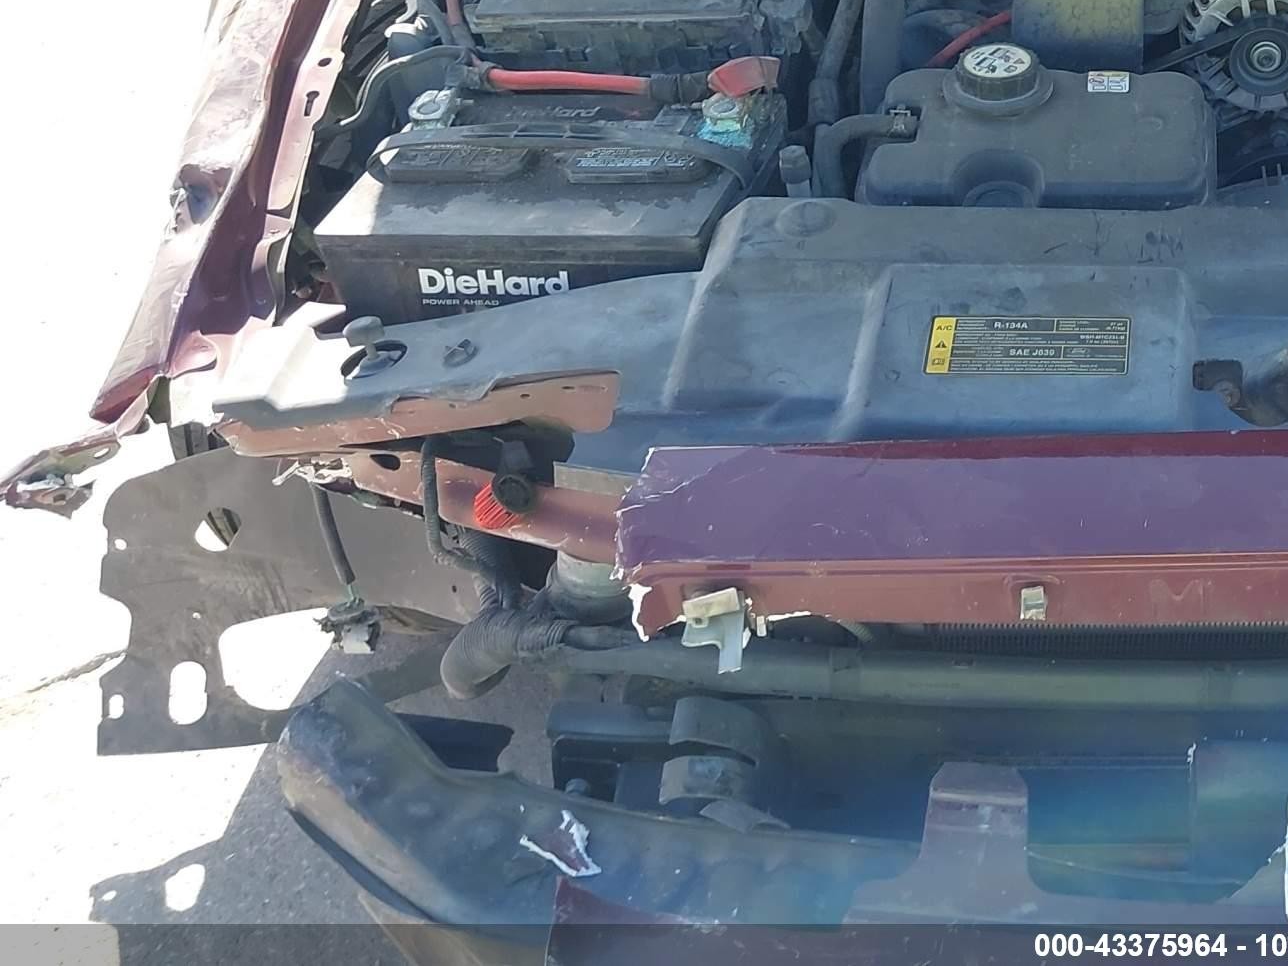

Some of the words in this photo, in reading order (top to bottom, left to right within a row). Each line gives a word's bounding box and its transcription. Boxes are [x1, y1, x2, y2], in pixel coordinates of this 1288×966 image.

[418, 267, 570, 296] DieHard
[422, 298, 460, 306] POWER
[463, 298, 500, 306] AHEAD
[935, 324, 953, 332] A/C
[993, 321, 1029, 330] R-134A
[1009, 348, 1031, 357] SAE
